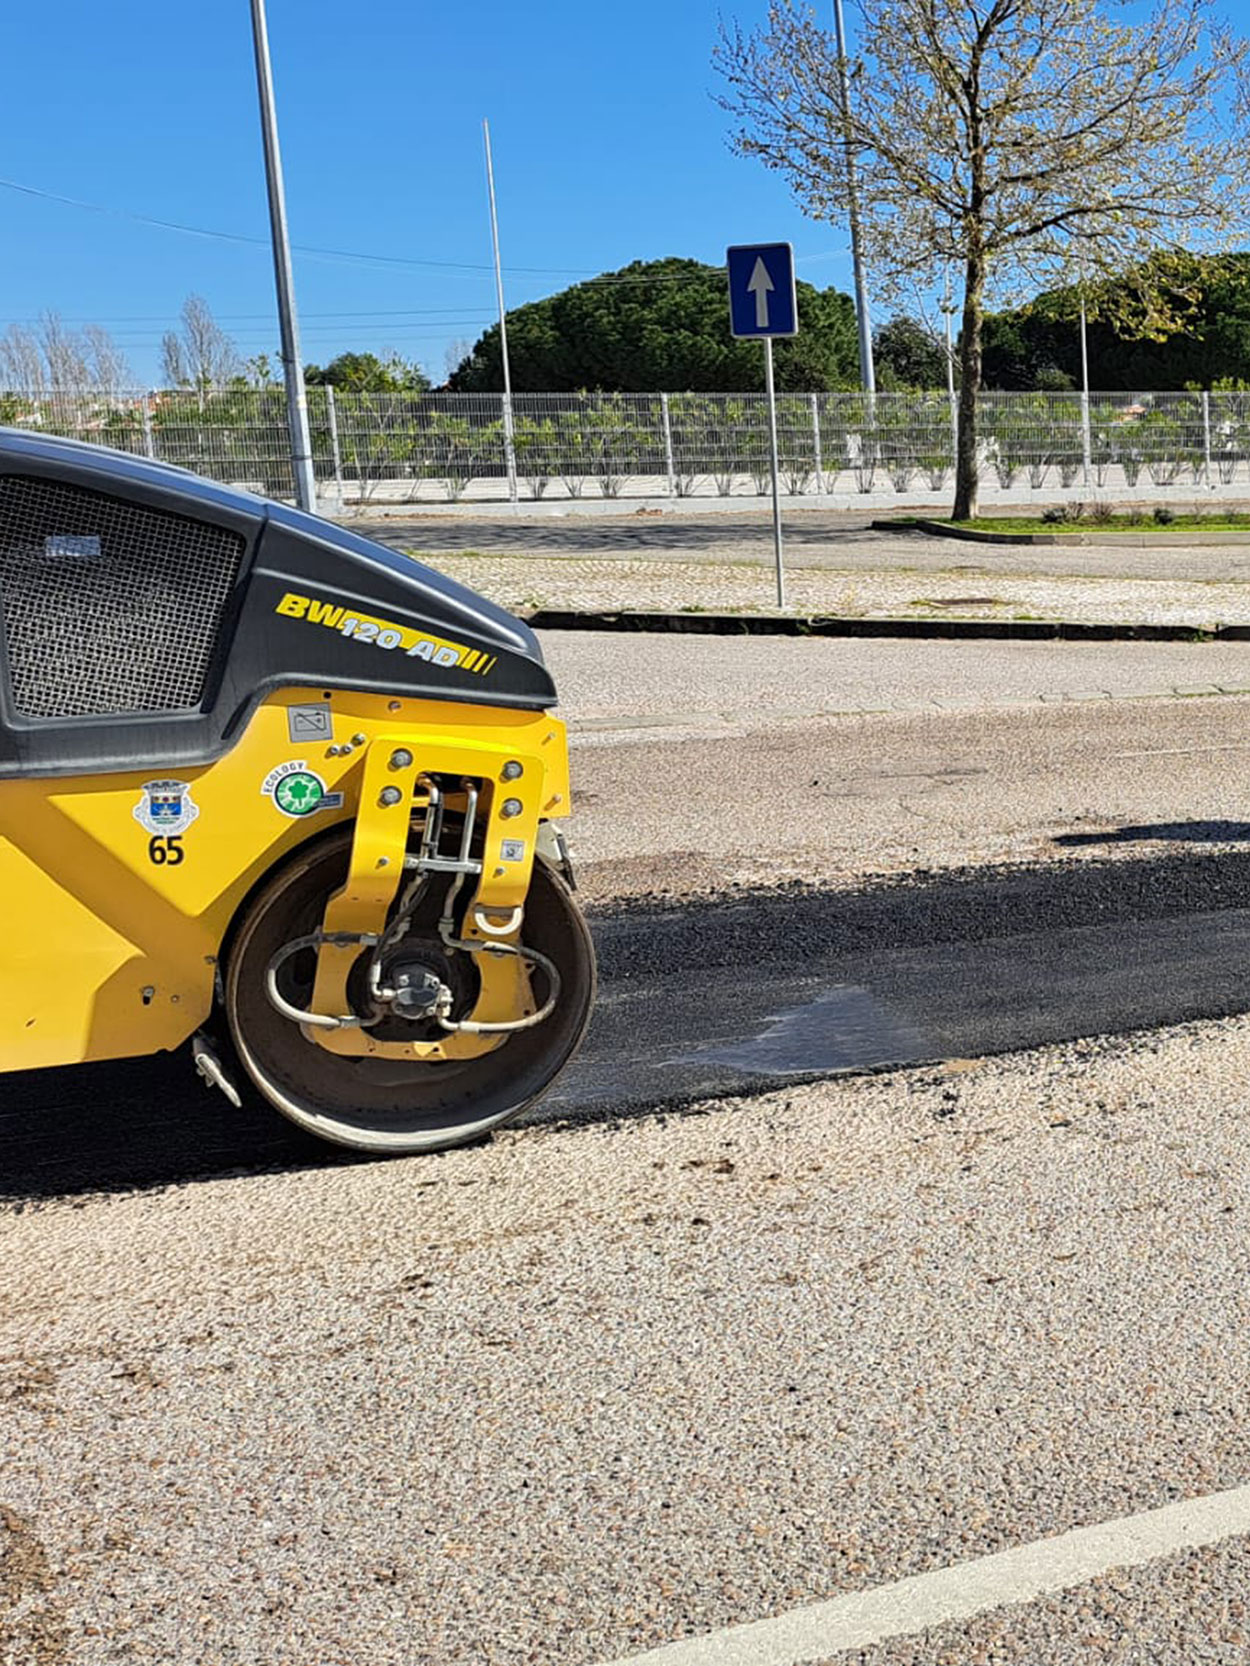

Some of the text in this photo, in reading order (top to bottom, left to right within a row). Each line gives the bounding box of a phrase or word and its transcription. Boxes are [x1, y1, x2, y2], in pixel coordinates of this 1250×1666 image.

[276, 593, 460, 668] BW 120 AD
[263, 762, 304, 793] ECOLOGY
[149, 835, 184, 865] 65
